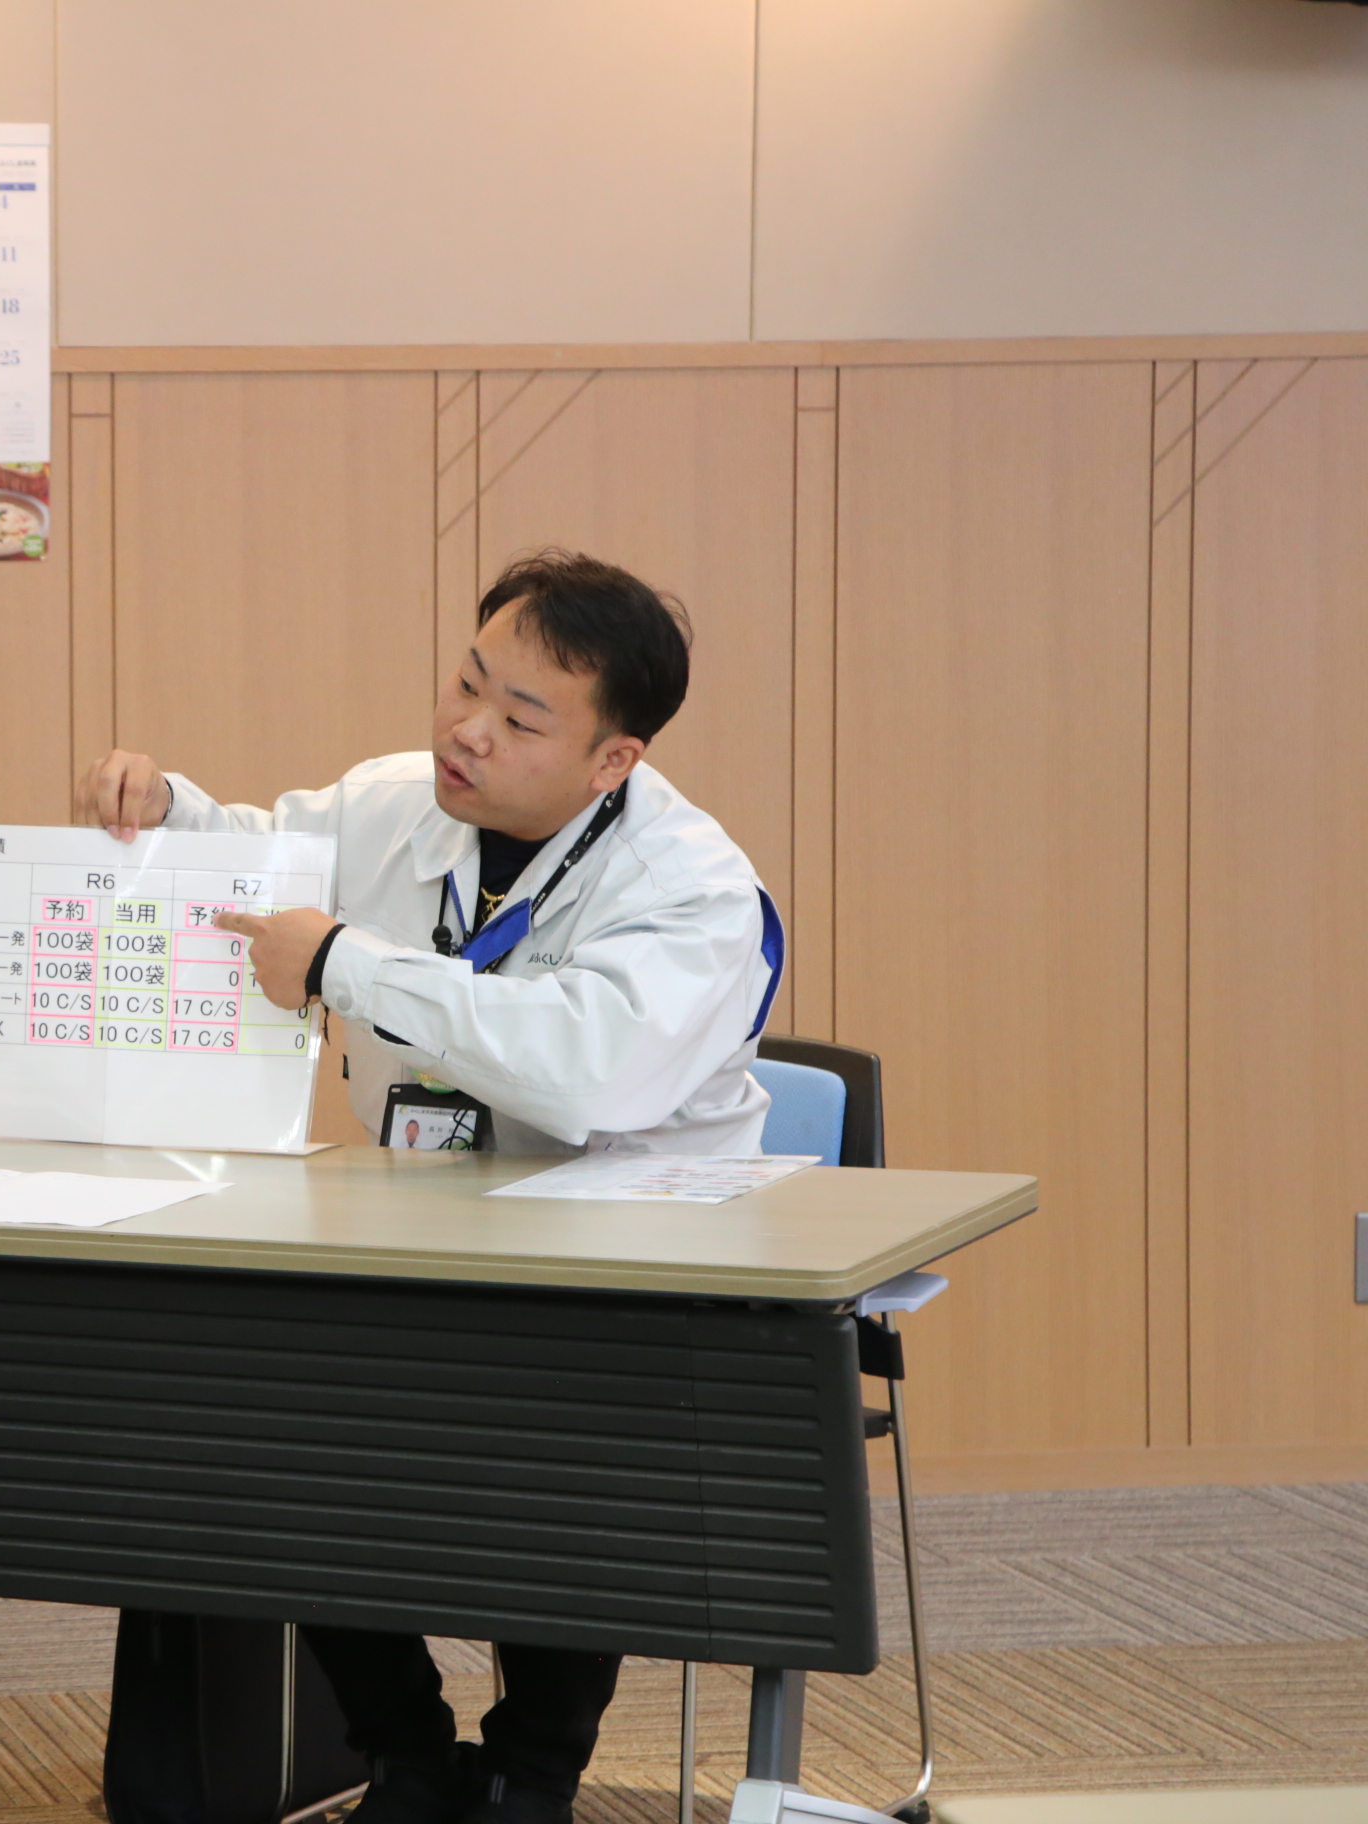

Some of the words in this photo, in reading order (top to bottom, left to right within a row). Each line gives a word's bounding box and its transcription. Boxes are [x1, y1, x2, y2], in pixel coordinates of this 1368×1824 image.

[0, 245, 18, 263] 11
[1, 298, 21, 315] 18
[0, 349, 21, 366] 25
[86, 873, 115, 890] R6
[233, 878, 262, 896] R7
[46, 900, 85, 920] 予約
[115, 903, 156, 923] 当用
[35, 931, 94, 951] 100袋
[104, 934, 166, 955] 100袋
[231, 940, 241, 956] 0
[34, 962, 92, 982] 100袋
[103, 965, 165, 985] 100袋
[229, 971, 239, 986] 0
[32, 992, 50, 1009] 10
[57, 994, 92, 1011] C/S
[101, 996, 118, 1012] 10
[127, 997, 164, 1014] C/S
[174, 999, 192, 1015] 17
[200, 1000, 237, 1017] C/S
[31, 1023, 48, 1039] 10
[55, 1024, 90, 1041] C/S
[99, 1026, 117, 1042] 10
[125, 1027, 163, 1045] C/S
[172, 1030, 190, 1045] 17
[198, 1031, 235, 1047] C/S
[295, 1034, 305, 1049] 0
